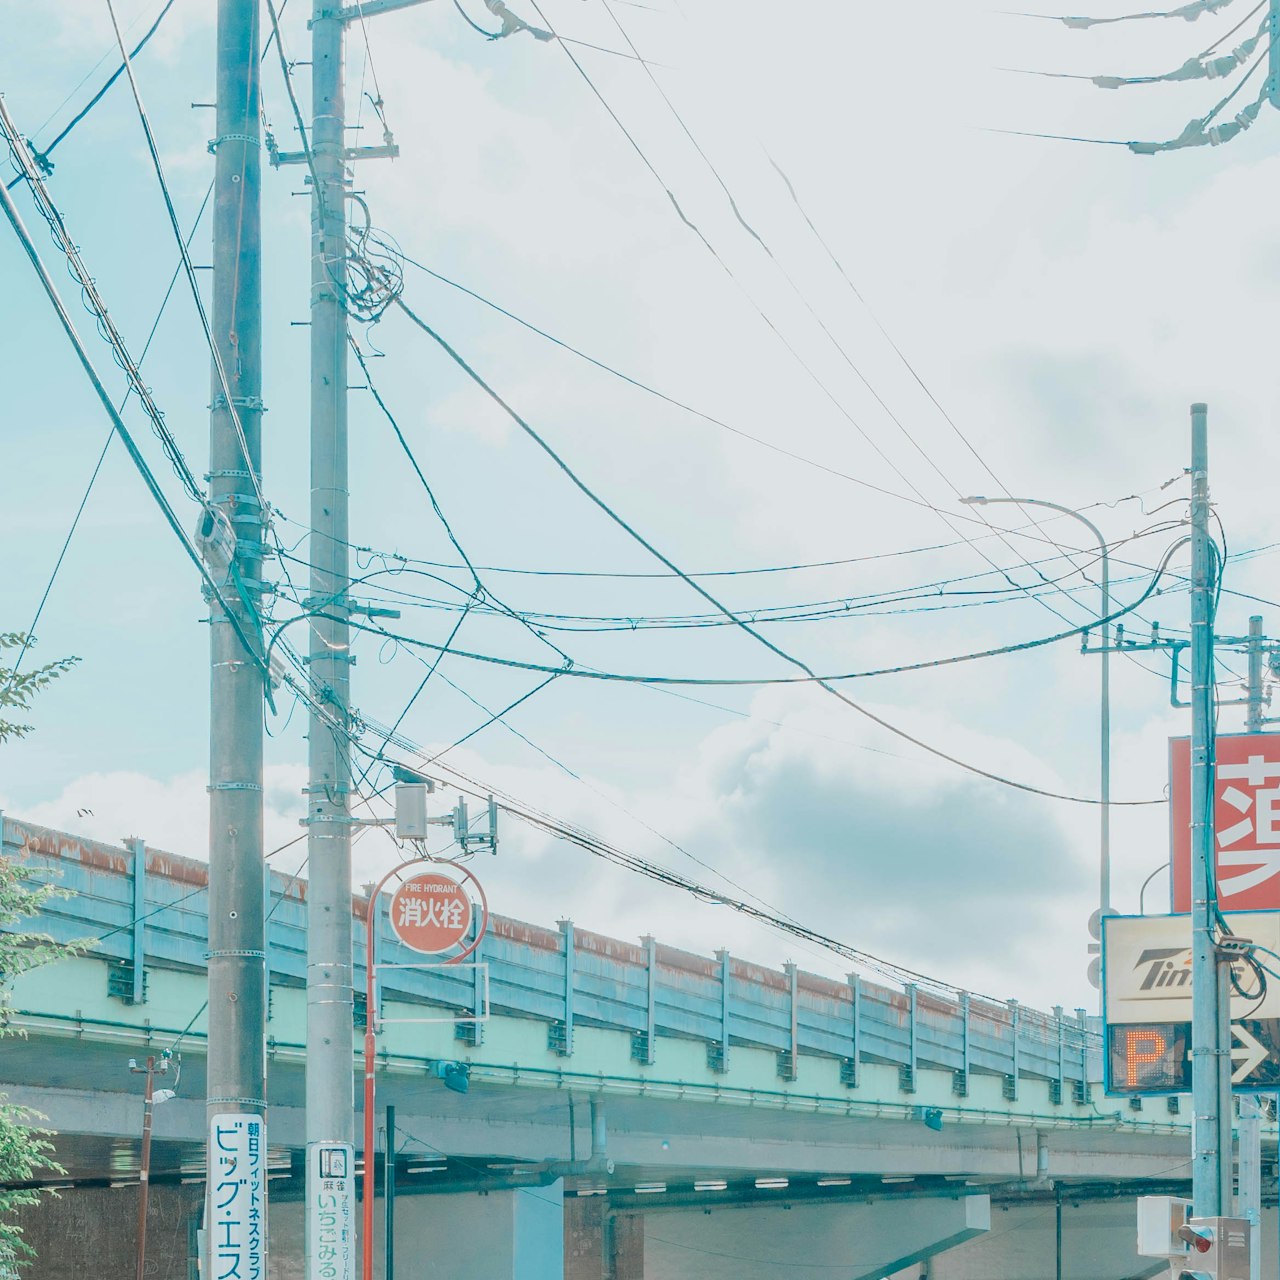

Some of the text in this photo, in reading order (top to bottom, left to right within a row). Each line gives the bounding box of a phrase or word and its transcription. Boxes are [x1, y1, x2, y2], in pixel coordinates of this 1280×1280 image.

[405, 884, 458, 894] FIRE HYDRANT
[398, 897, 464, 929] 消火栓
[1133, 947, 1244, 991] Tims
[1126, 1031, 1165, 1086] P
[216, 1121, 248, 1280] ビッグ・エス
[247, 1122, 261, 1280] 朝日フィットネスクラブ
[323, 1181, 346, 1192] 麻雀
